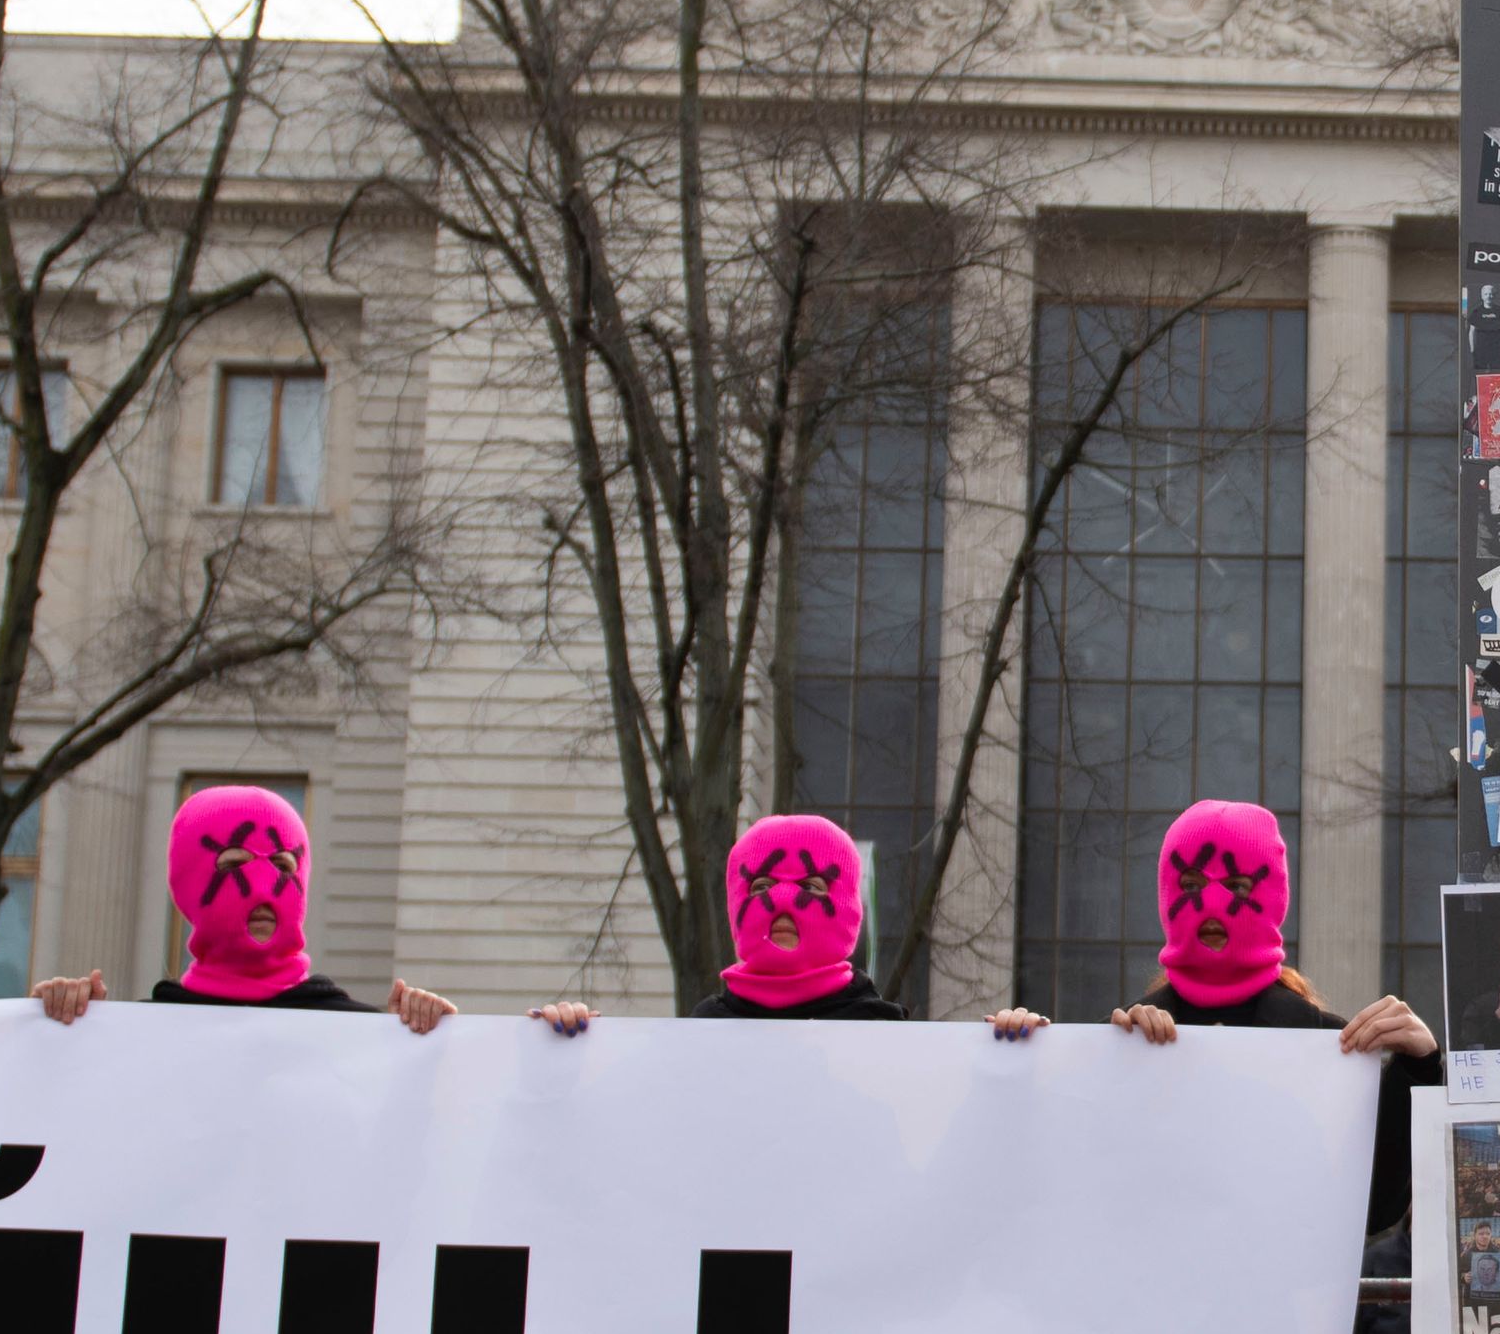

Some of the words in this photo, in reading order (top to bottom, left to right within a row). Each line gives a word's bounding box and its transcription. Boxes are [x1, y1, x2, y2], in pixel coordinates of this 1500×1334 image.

[1484, 179, 1495, 193] in
[1455, 1053, 1482, 1066] НЕ
[1460, 1076, 1484, 1090] НЕ
